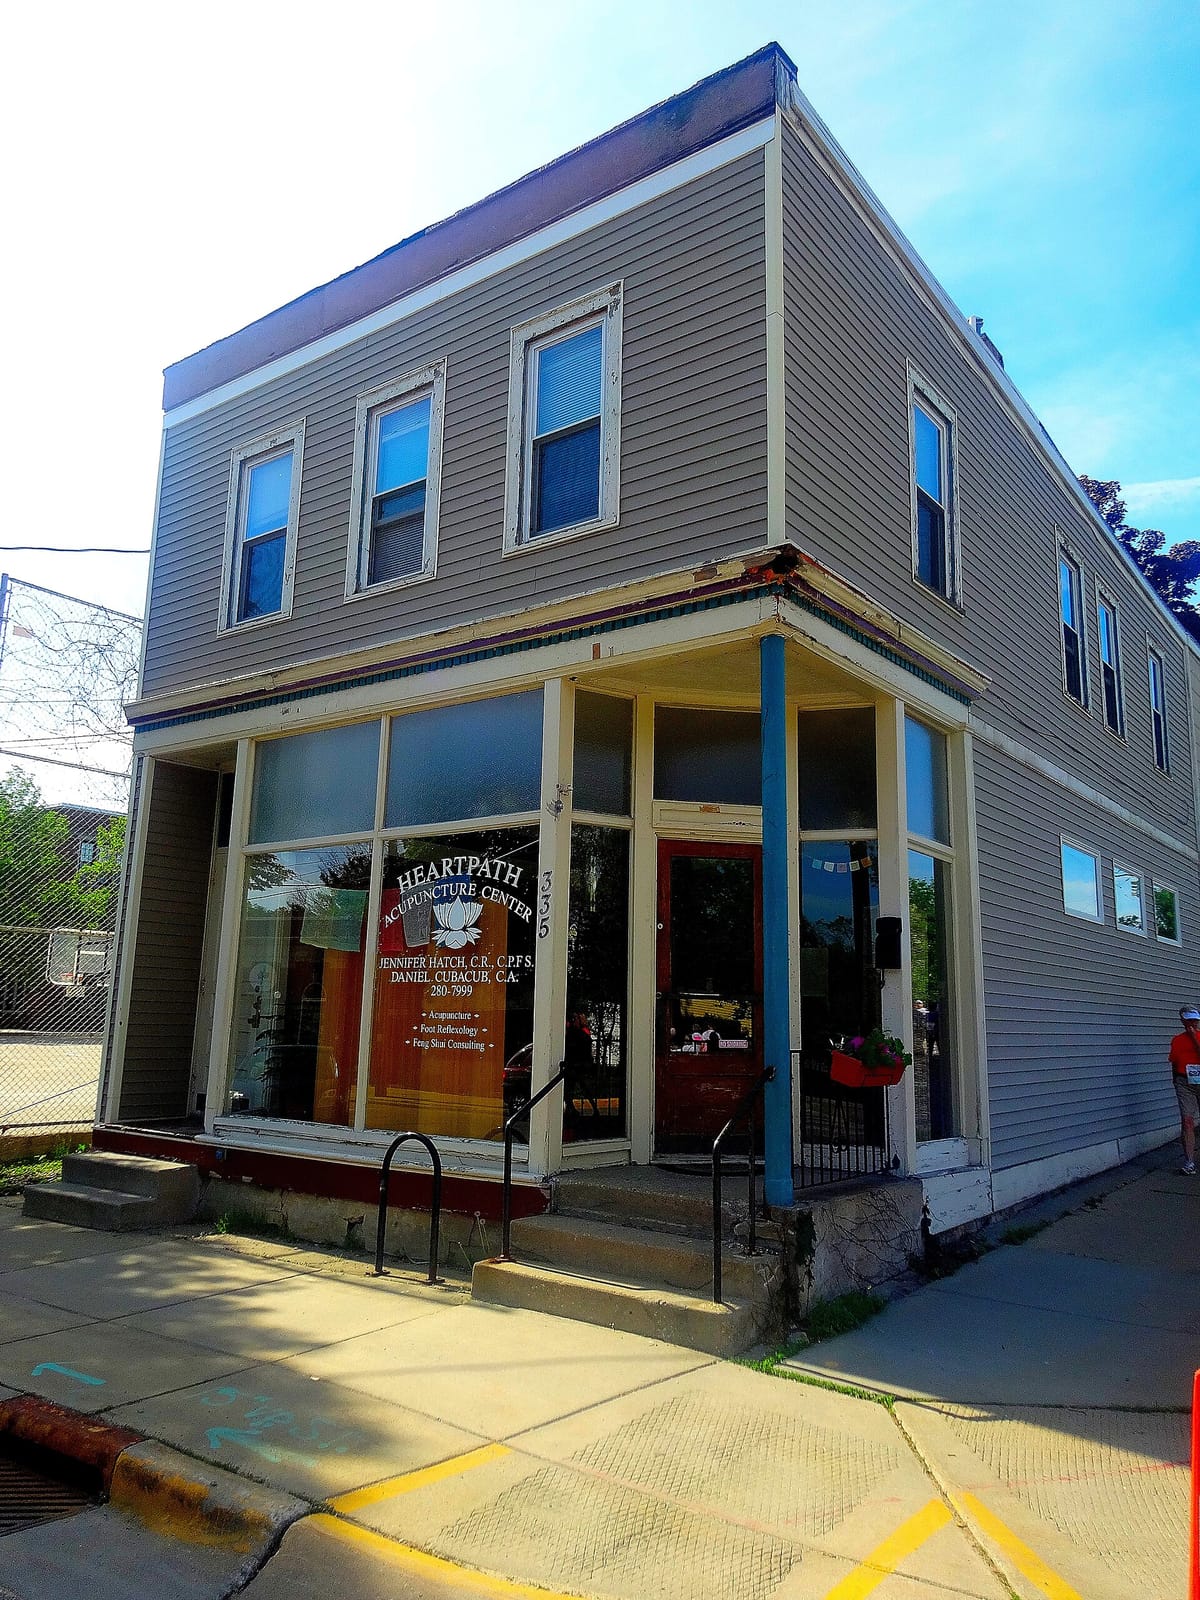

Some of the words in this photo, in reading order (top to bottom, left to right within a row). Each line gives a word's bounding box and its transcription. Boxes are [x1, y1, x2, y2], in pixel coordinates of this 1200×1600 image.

[397, 856, 524, 894] HEARTPATH
[384, 883, 477, 928] ACUPUNCTURE
[481, 886, 532, 923] CENTER
[539, 870, 552, 938] 335
[379, 957, 426, 969] JENNIFER
[429, 956, 468, 970] HATCH,
[470, 955, 494, 969] C.R.,
[391, 971, 431, 983] DANIEL
[435, 971, 491, 984] CUBACUB,
[495, 971, 519, 983] C.A.
[430, 984, 473, 997] 280-7999
[428, 1010, 472, 1021] Acupuncture
[420, 1023, 436, 1033] Foot
[436, 1024, 479, 1036] Reflexology
[413, 1037, 429, 1050] Feng
[430, 1038, 446, 1048] Shui
[447, 1039, 485, 1053] Consulting
